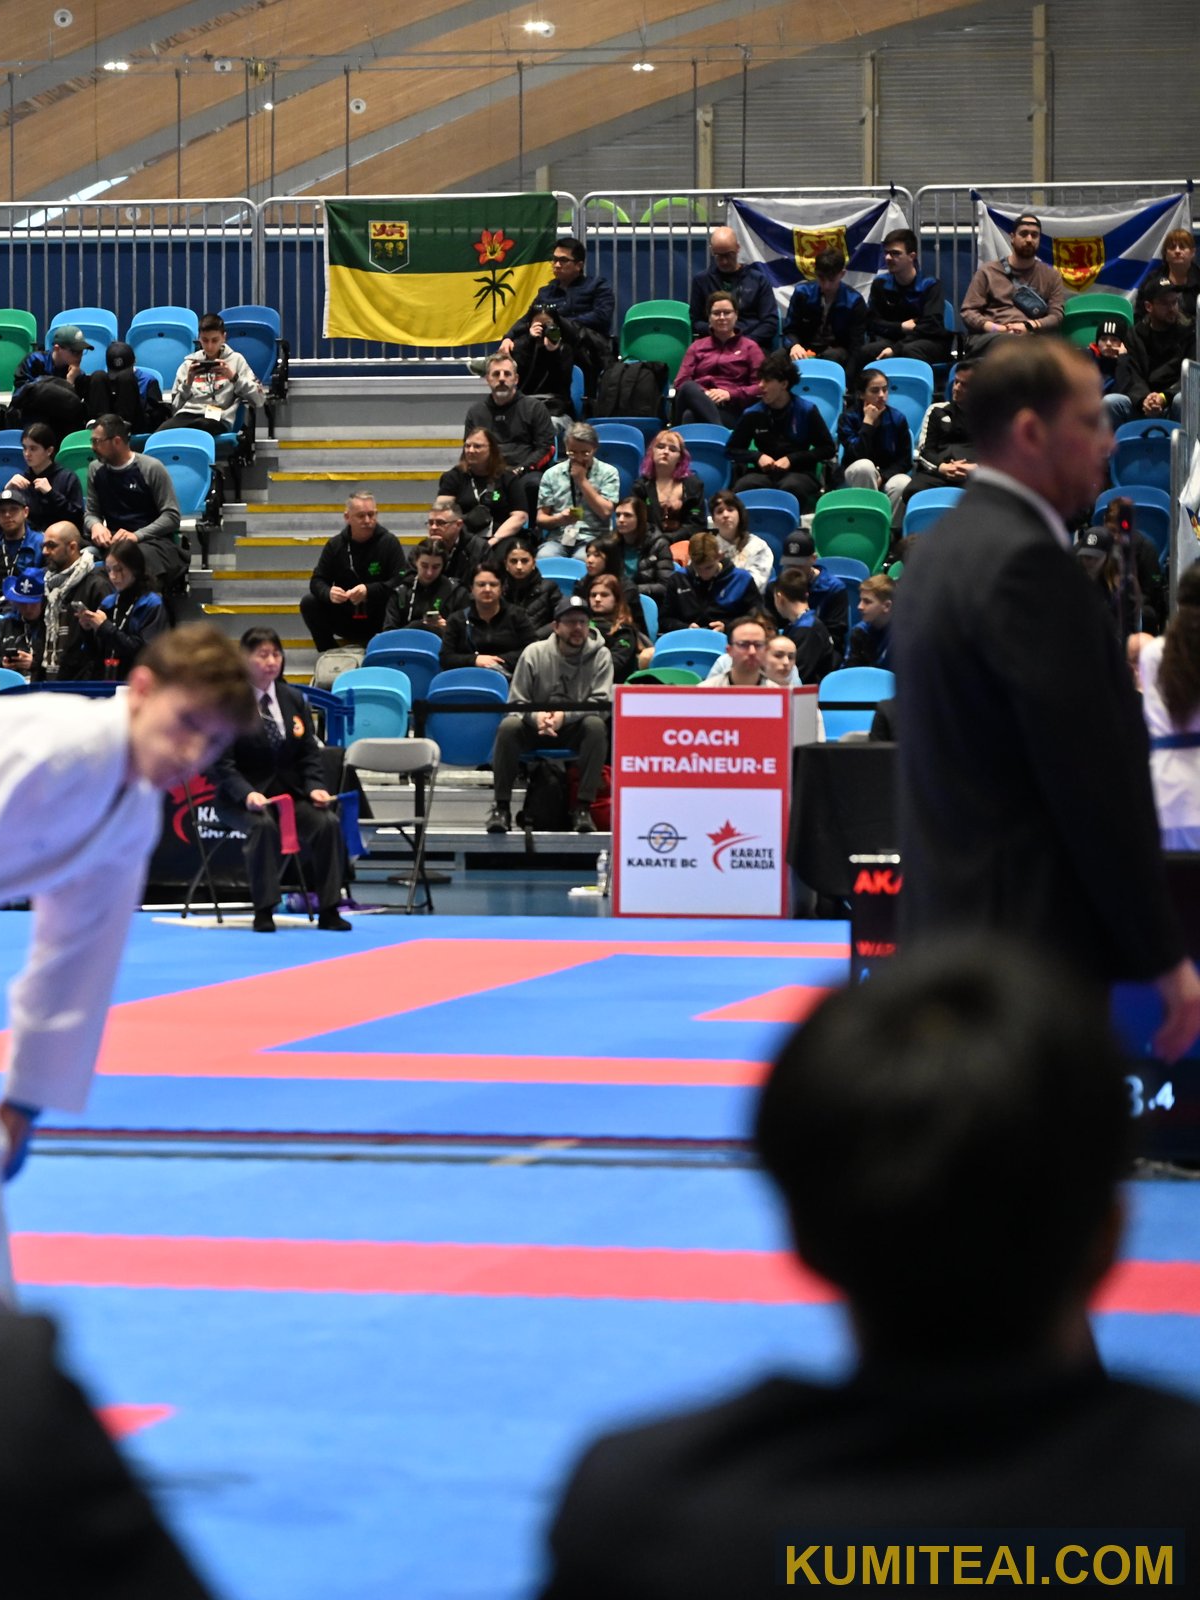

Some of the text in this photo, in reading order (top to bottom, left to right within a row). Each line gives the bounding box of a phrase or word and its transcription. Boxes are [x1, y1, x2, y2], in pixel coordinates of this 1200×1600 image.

[662, 729, 740, 746] COACH
[730, 848, 775, 859] KARATE
[627, 858, 698, 868] KARATE BC
[730, 859, 776, 870] CANADA
